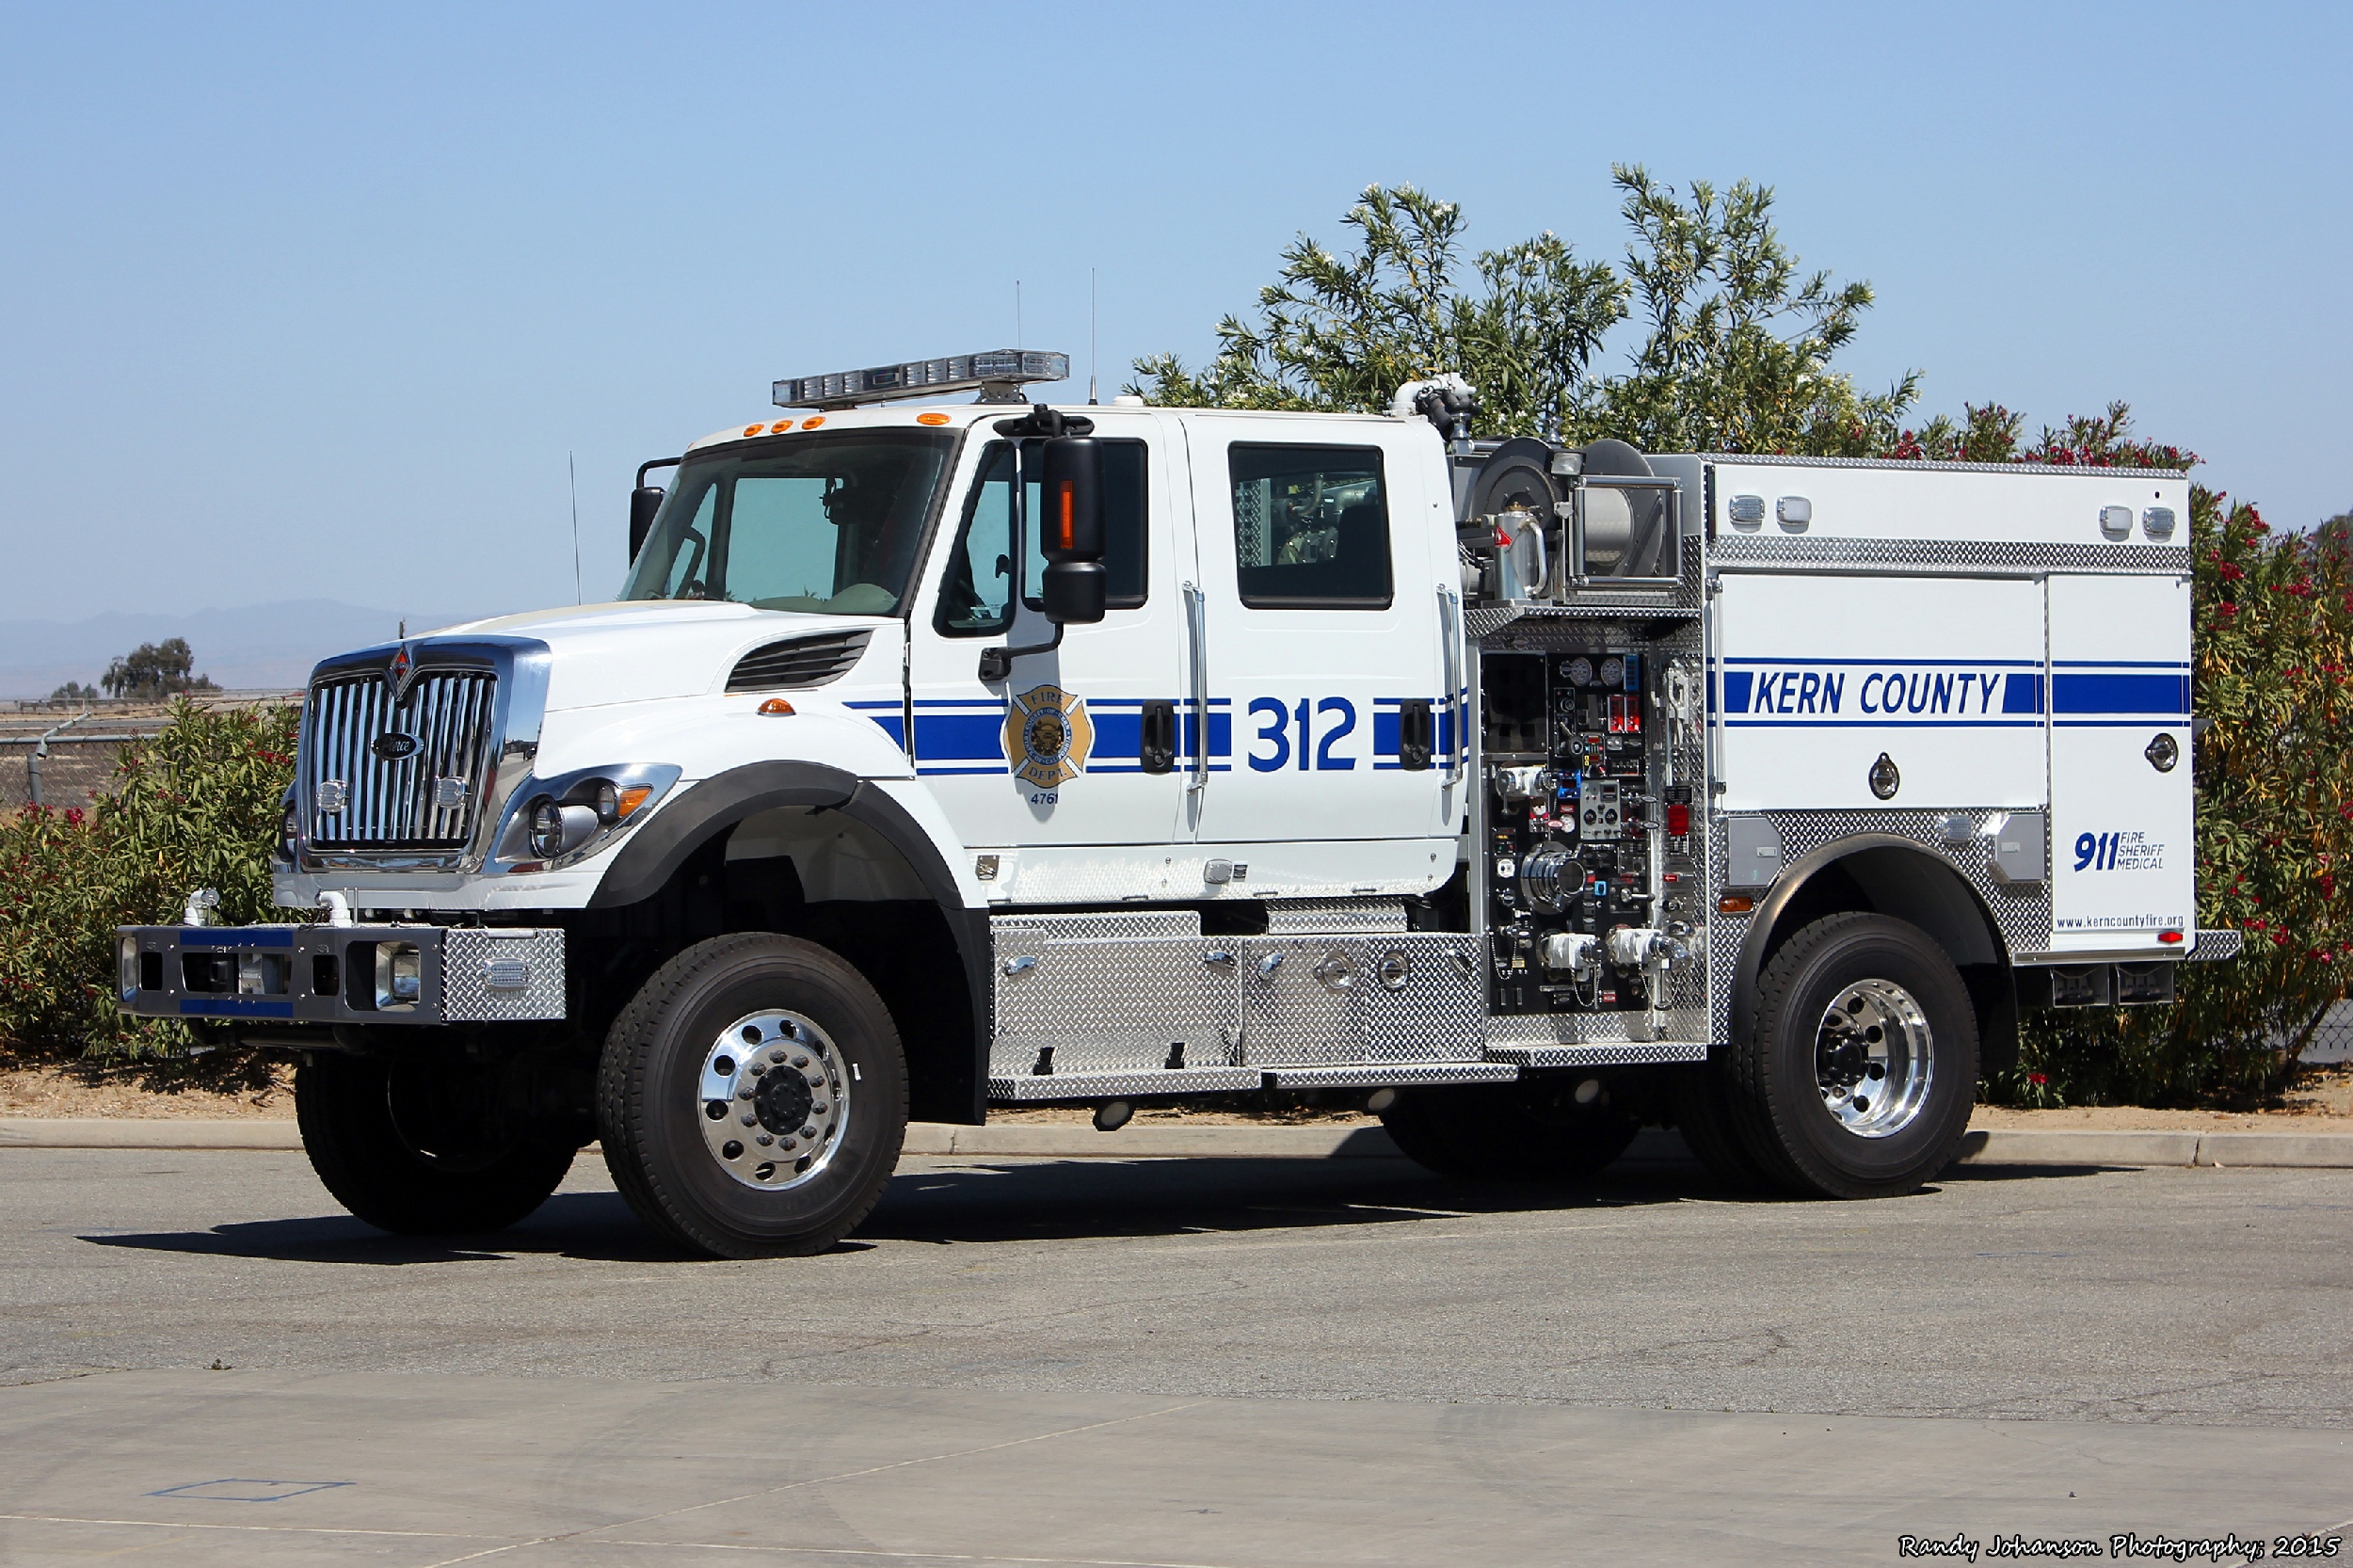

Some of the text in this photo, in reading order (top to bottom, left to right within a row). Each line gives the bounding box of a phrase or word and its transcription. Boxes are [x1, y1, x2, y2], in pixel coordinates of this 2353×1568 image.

[1031, 691, 1065, 706] FIRE
[1753, 672, 2001, 714] KERN COUNTY
[1248, 696, 1356, 773] 312
[1028, 766, 1067, 781] DEPT.
[2120, 831, 2145, 843] FIRE
[2073, 832, 2121, 872] 911
[2118, 844, 2165, 856] SHERIFF
[2116, 857, 2164, 871] MEDICAL
[2057, 913, 2184, 928] www.kerncountyfire.org
